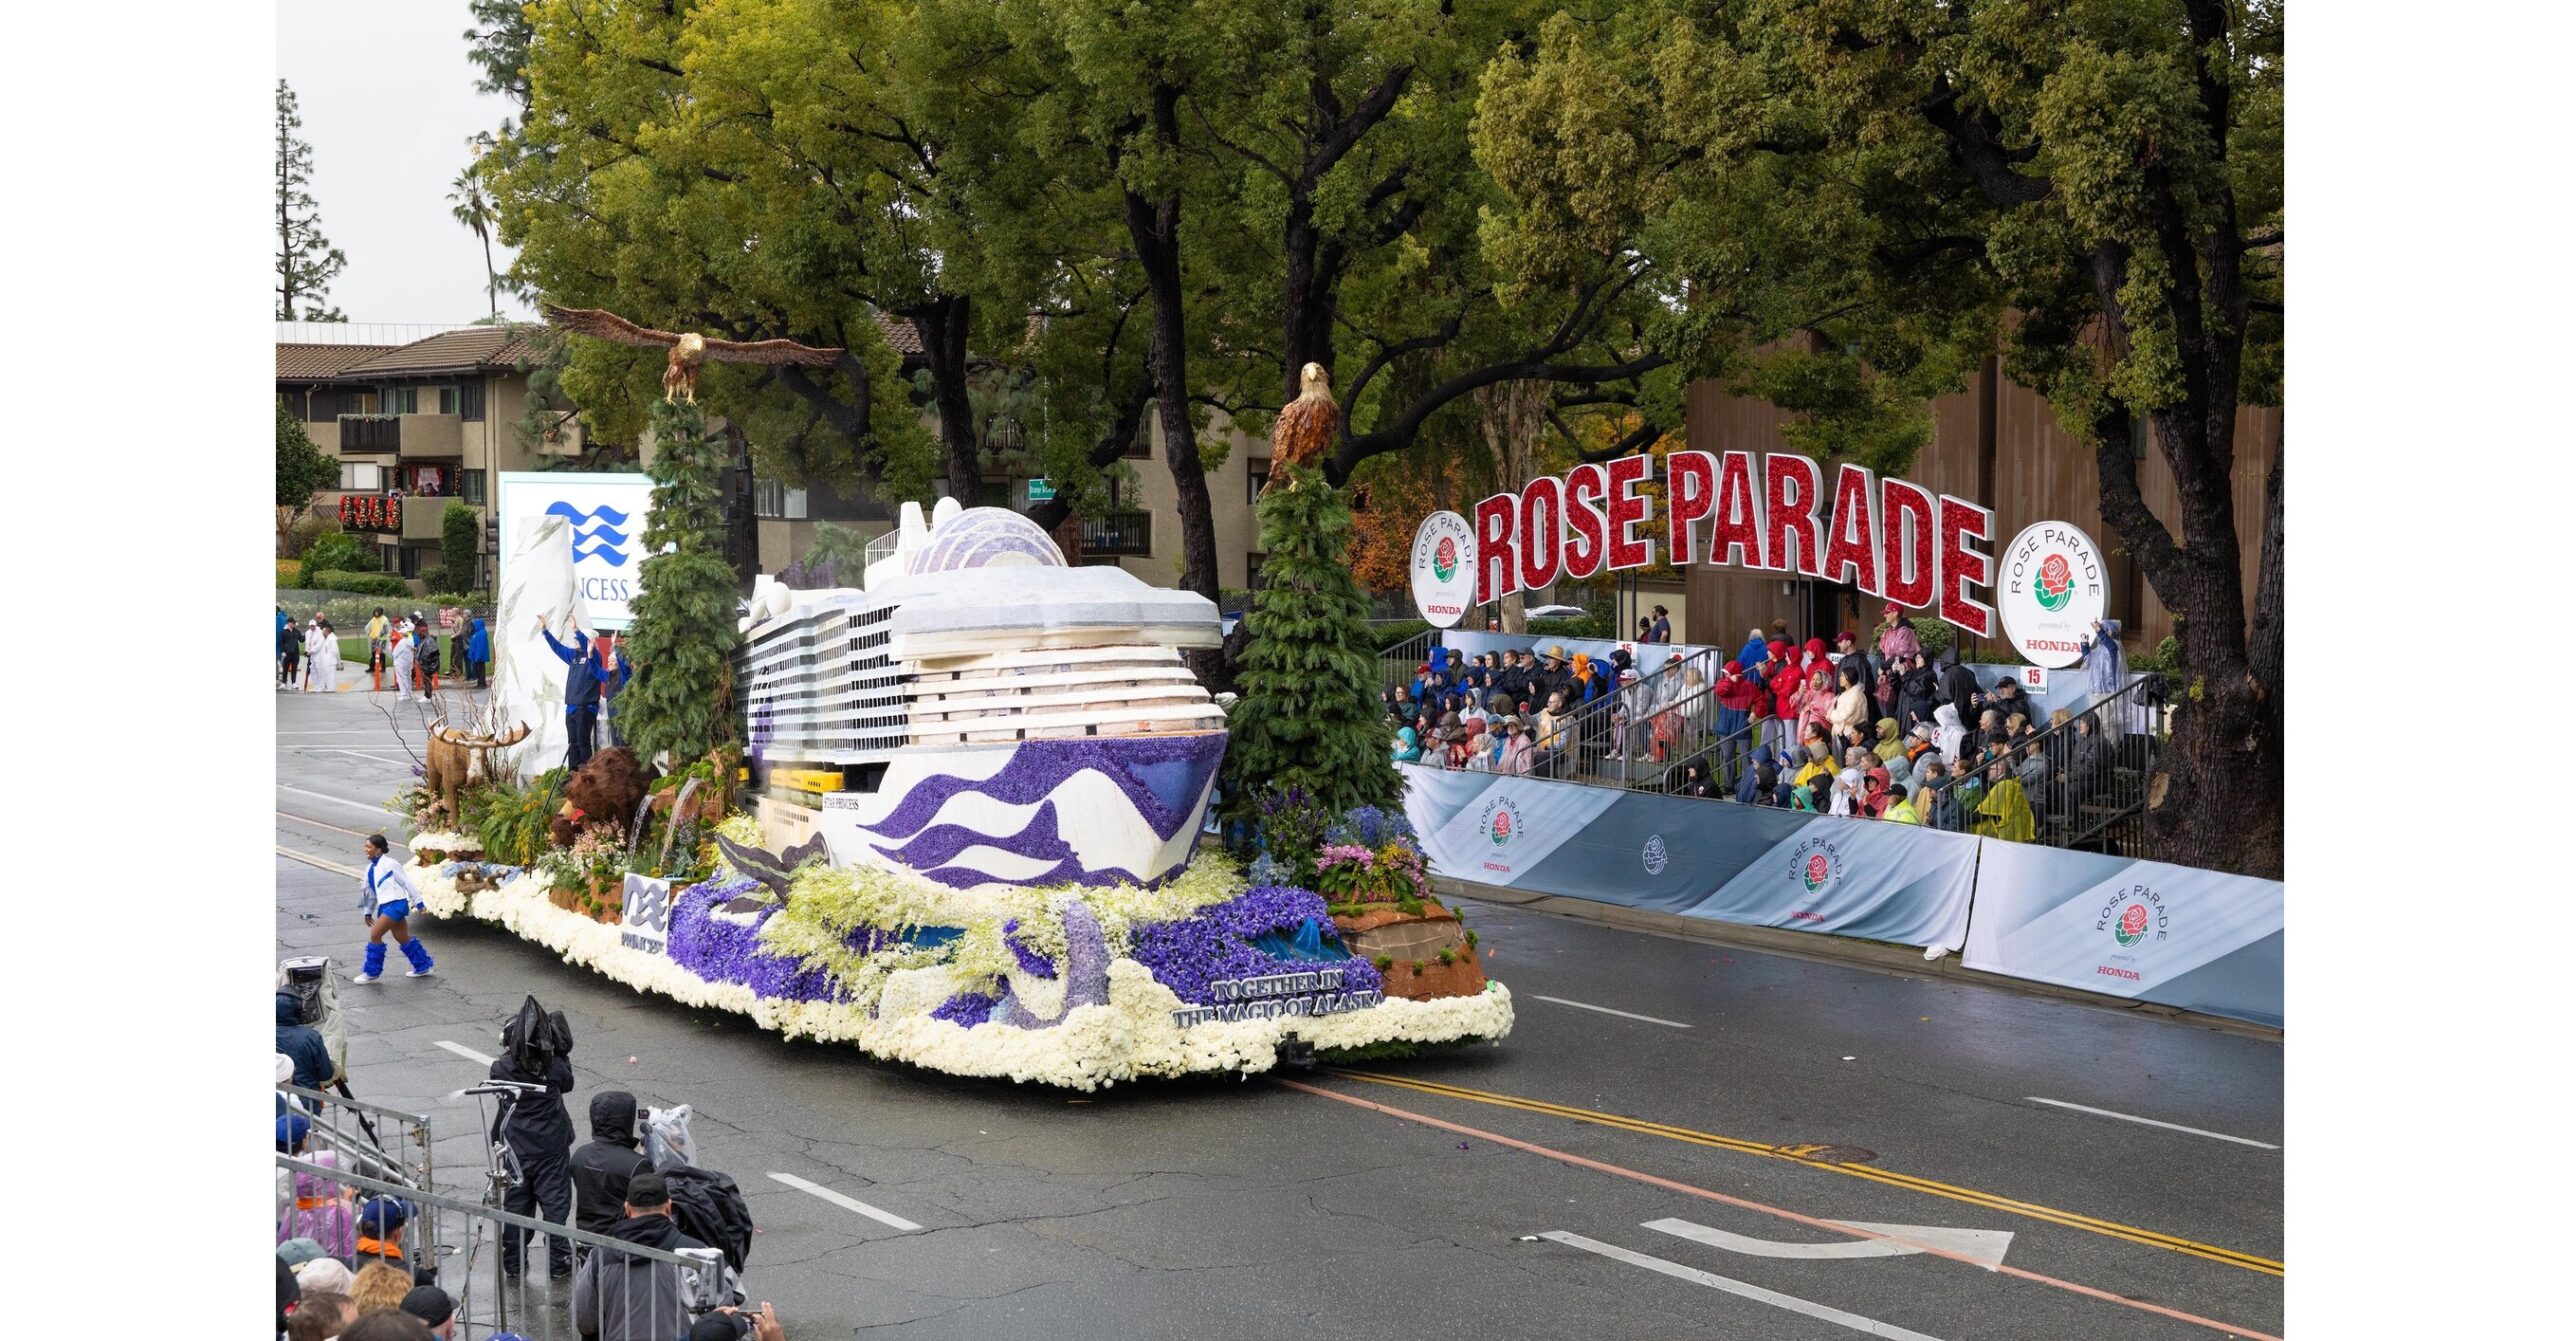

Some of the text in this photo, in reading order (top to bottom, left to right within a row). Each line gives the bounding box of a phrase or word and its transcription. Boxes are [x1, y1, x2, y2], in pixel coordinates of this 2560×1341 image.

[1419, 517, 1473, 571] ROSE PARADE
[1475, 450, 1996, 640] ROSE PARADE
[2011, 529, 2100, 597] ROSE PARADE
[580, 577, 628, 601] NCESS
[1428, 605, 1462, 615] HONDA
[2026, 639, 2081, 653] HONDA
[2027, 668, 2041, 685] 15
[1480, 796, 1524, 840] ROSE PARADE
[1483, 863, 1511, 873] HONDA
[1788, 837, 1843, 886] ROSE PARADE
[1791, 911, 1826, 922] HONDA
[2097, 884, 2169, 941] ROSE PARADE
[1211, 968, 1344, 1001] TOGETHER IN
[2096, 965, 2141, 981] HONDA
[1171, 989, 1384, 1029] THE MAGIC OF ALASKA
